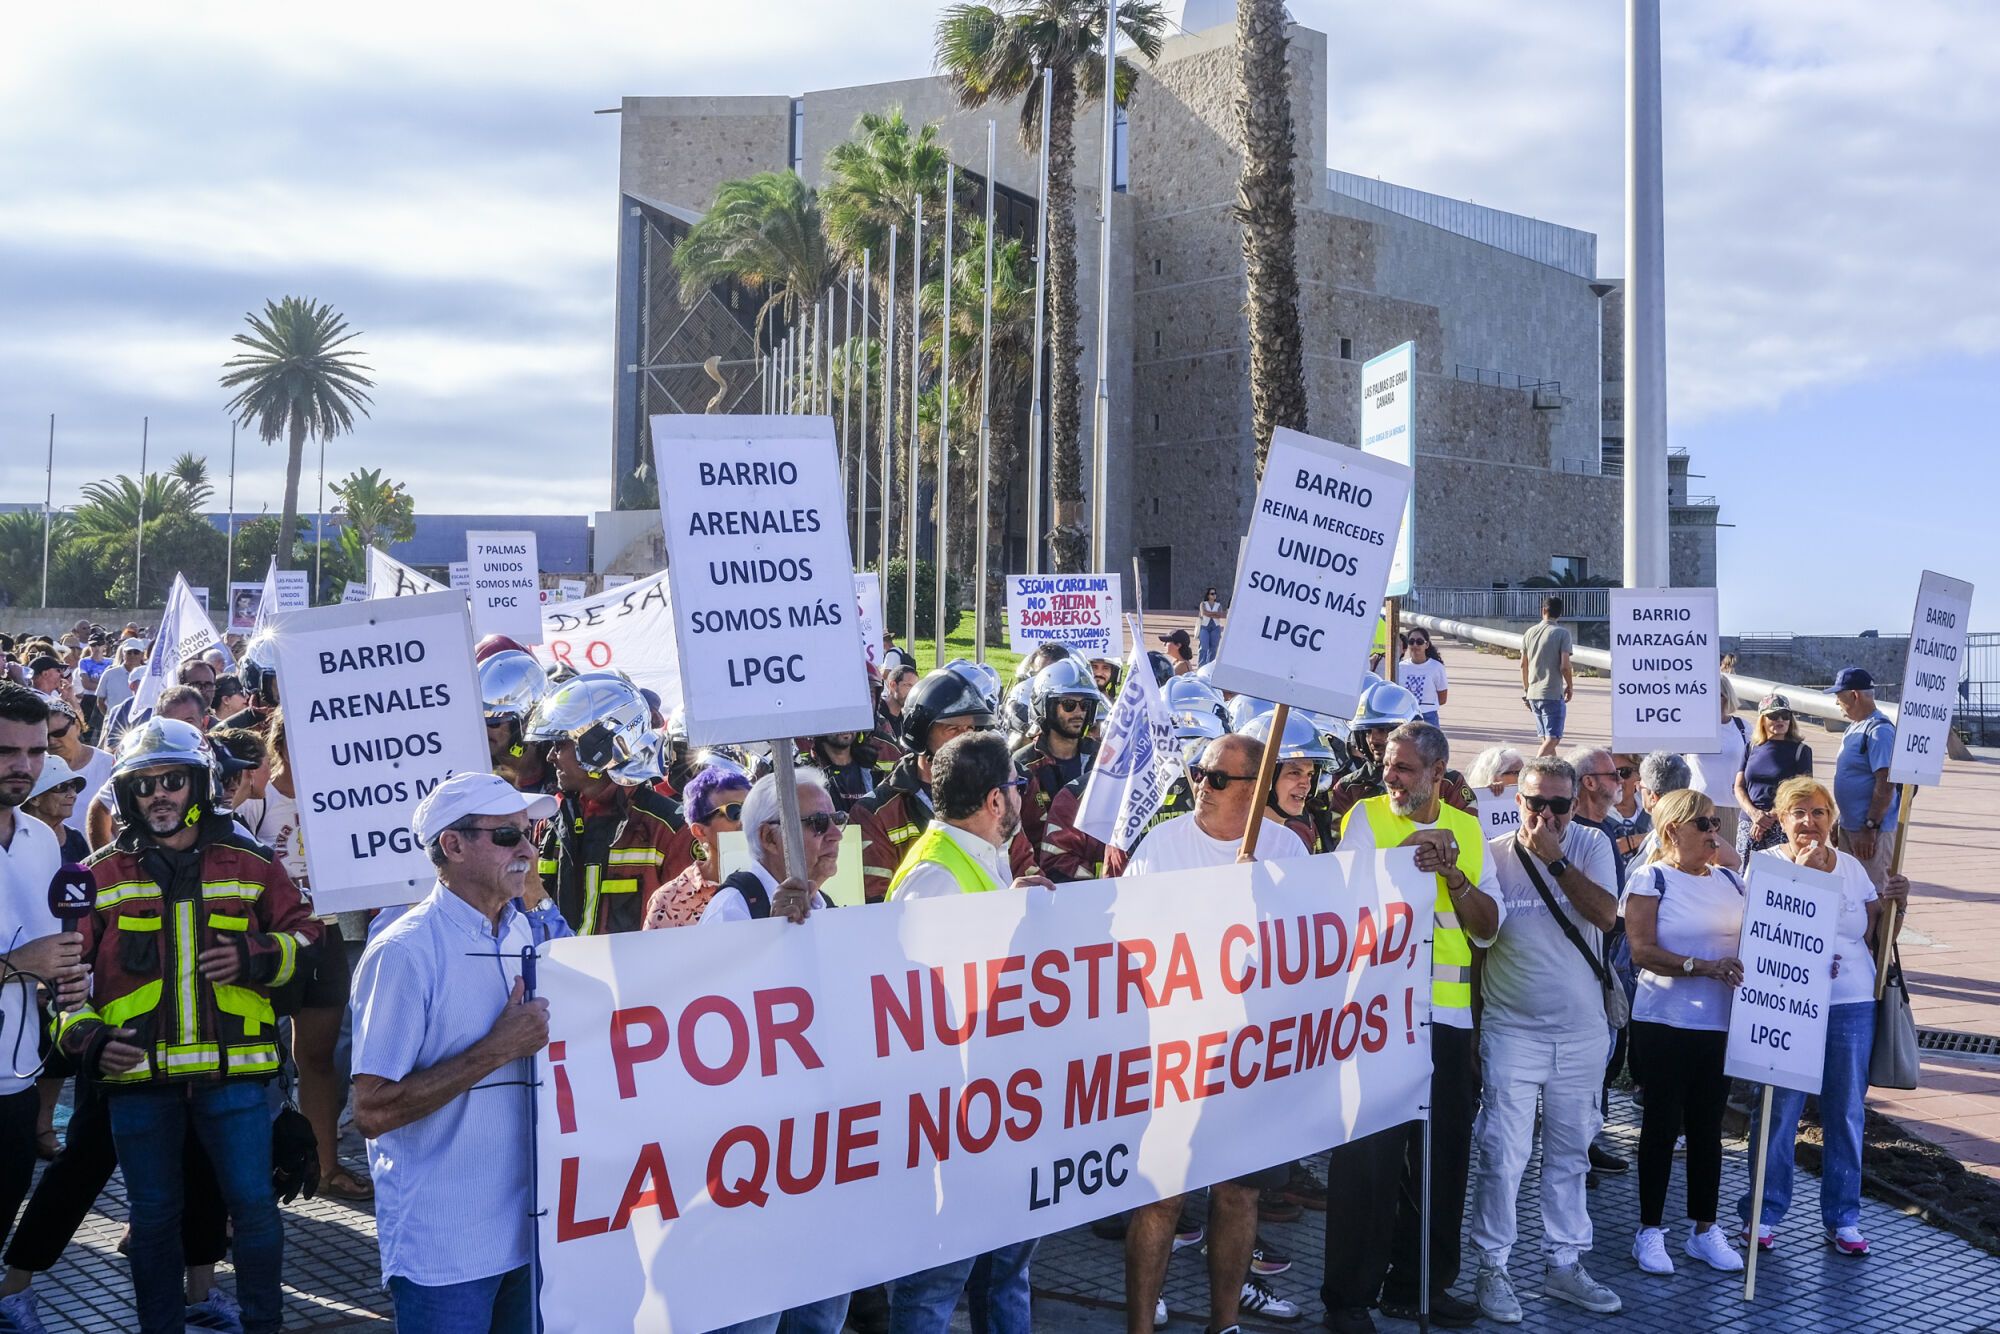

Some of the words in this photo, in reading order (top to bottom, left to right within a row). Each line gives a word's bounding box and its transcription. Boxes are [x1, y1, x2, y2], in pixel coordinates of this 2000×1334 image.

[1373, 378, 1389, 396] PALMAS
[1389, 375, 1395, 388] DE
[1395, 369, 1408, 386] GRAN
[1376, 391, 1395, 409] CANARIA
[699, 461, 798, 486] BARRIO
[1295, 468, 1373, 508] BARRIO
[689, 508, 821, 536] ARENALES
[1262, 498, 1308, 525] REINA
[1312, 513, 1385, 546] MERCEDES
[477, 545, 484, 555] 7
[487, 546, 526, 554] PALMAS
[1277, 536, 1359, 577] UNIDOS
[484, 562, 523, 572] UNIDOS
[709, 557, 813, 586] UNIDOS
[476, 579, 510, 589] SOMOS
[512, 577, 533, 588] MÁS
[1016, 576, 1054, 596] SEGÚN
[1056, 578, 1108, 593] CAROLINA
[1248, 570, 1322, 605] SOMOS
[1324, 591, 1367, 618] MÁS
[489, 597, 517, 607] LPGC
[1027, 596, 1046, 610] NO
[1050, 594, 1097, 611] FALTAN
[1632, 608, 1691, 621] BARRIO
[691, 606, 782, 634] SOMOS
[788, 598, 842, 628] MÁS
[1020, 609, 1102, 627] BOMBEROS
[1926, 607, 1956, 629] BARRIO
[1021, 628, 1069, 640] ENTONCES
[1070, 627, 1111, 640] JUGAMOS
[1261, 615, 1325, 652] LPGC
[1617, 630, 1707, 646] MARZAGÁN
[319, 639, 426, 675] BARRIO
[1913, 636, 1957, 662] ATLÁNTICO
[727, 654, 806, 688] LPGC
[1633, 659, 1692, 671] UNIDOS
[1618, 682, 1671, 695] SOMOS
[1675, 679, 1708, 695] MÁS
[1915, 670, 1947, 692] UNIDOS
[309, 683, 451, 723] ARENALES
[1636, 707, 1682, 723] LPGC
[1903, 700, 1931, 719] SOMOS
[1931, 706, 1947, 721] MÁS
[331, 731, 442, 769] UNIDOS
[1906, 733, 1931, 755] LPGC
[312, 781, 409, 813] SOMOS
[1491, 810, 1520, 826] BAR
[1765, 889, 1816, 918] BARRIO
[1749, 920, 1824, 955] ATLÁNTICO
[1756, 956, 1810, 985] UNIDOS
[609, 986, 825, 1100] POR
[870, 932, 1204, 1058] NUESTRA
[1219, 901, 1418, 995] CIUDAD,
[1740, 986, 1786, 1012] SOMOS
[1789, 998, 1819, 1020] MÁS
[1750, 1023, 1792, 1051] LPGC
[557, 1142, 680, 1244] LA
[705, 1101, 882, 1209] QUE
[906, 1067, 1043, 1169] NOS
[1063, 994, 1389, 1130] MERECEMOS
[1029, 1143, 1129, 1212] LPGC
